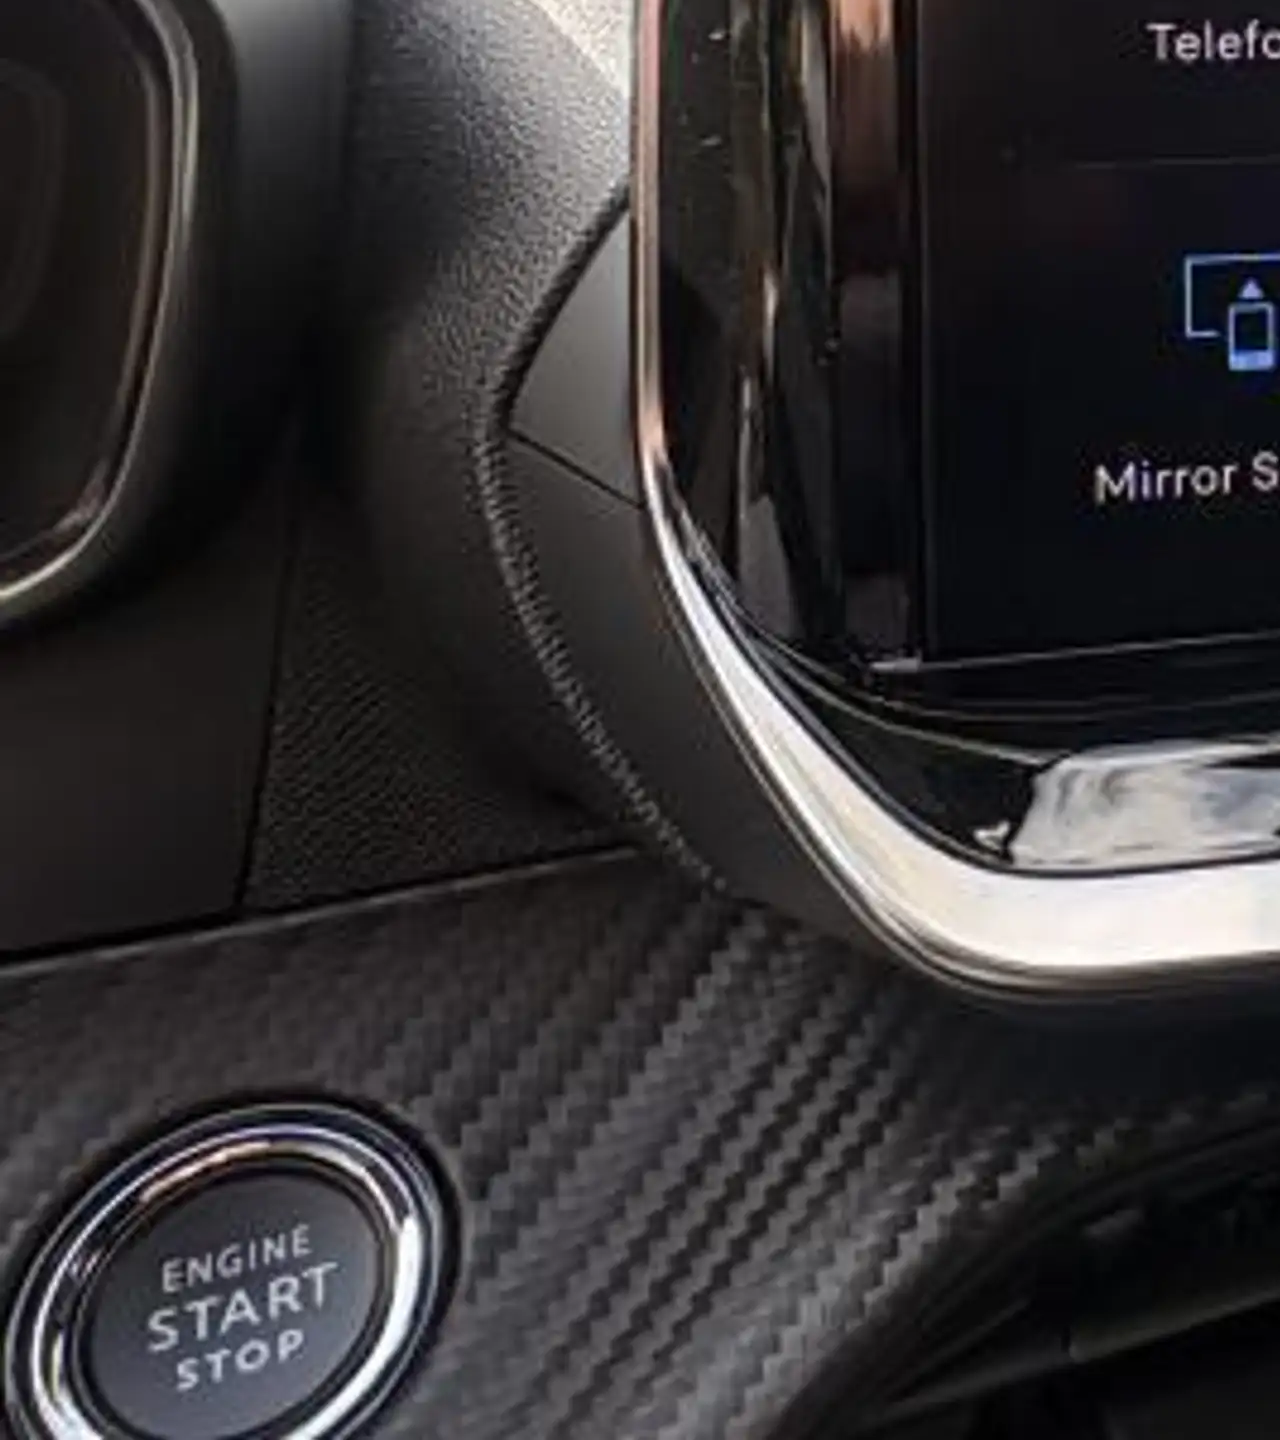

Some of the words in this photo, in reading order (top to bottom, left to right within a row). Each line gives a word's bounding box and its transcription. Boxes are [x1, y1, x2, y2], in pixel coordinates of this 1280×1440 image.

[1094, 461, 1238, 504] Mirror
[161, 1224, 314, 1293] ENGINE
[147, 1262, 338, 1352] START
[176, 1329, 304, 1392] STOP
